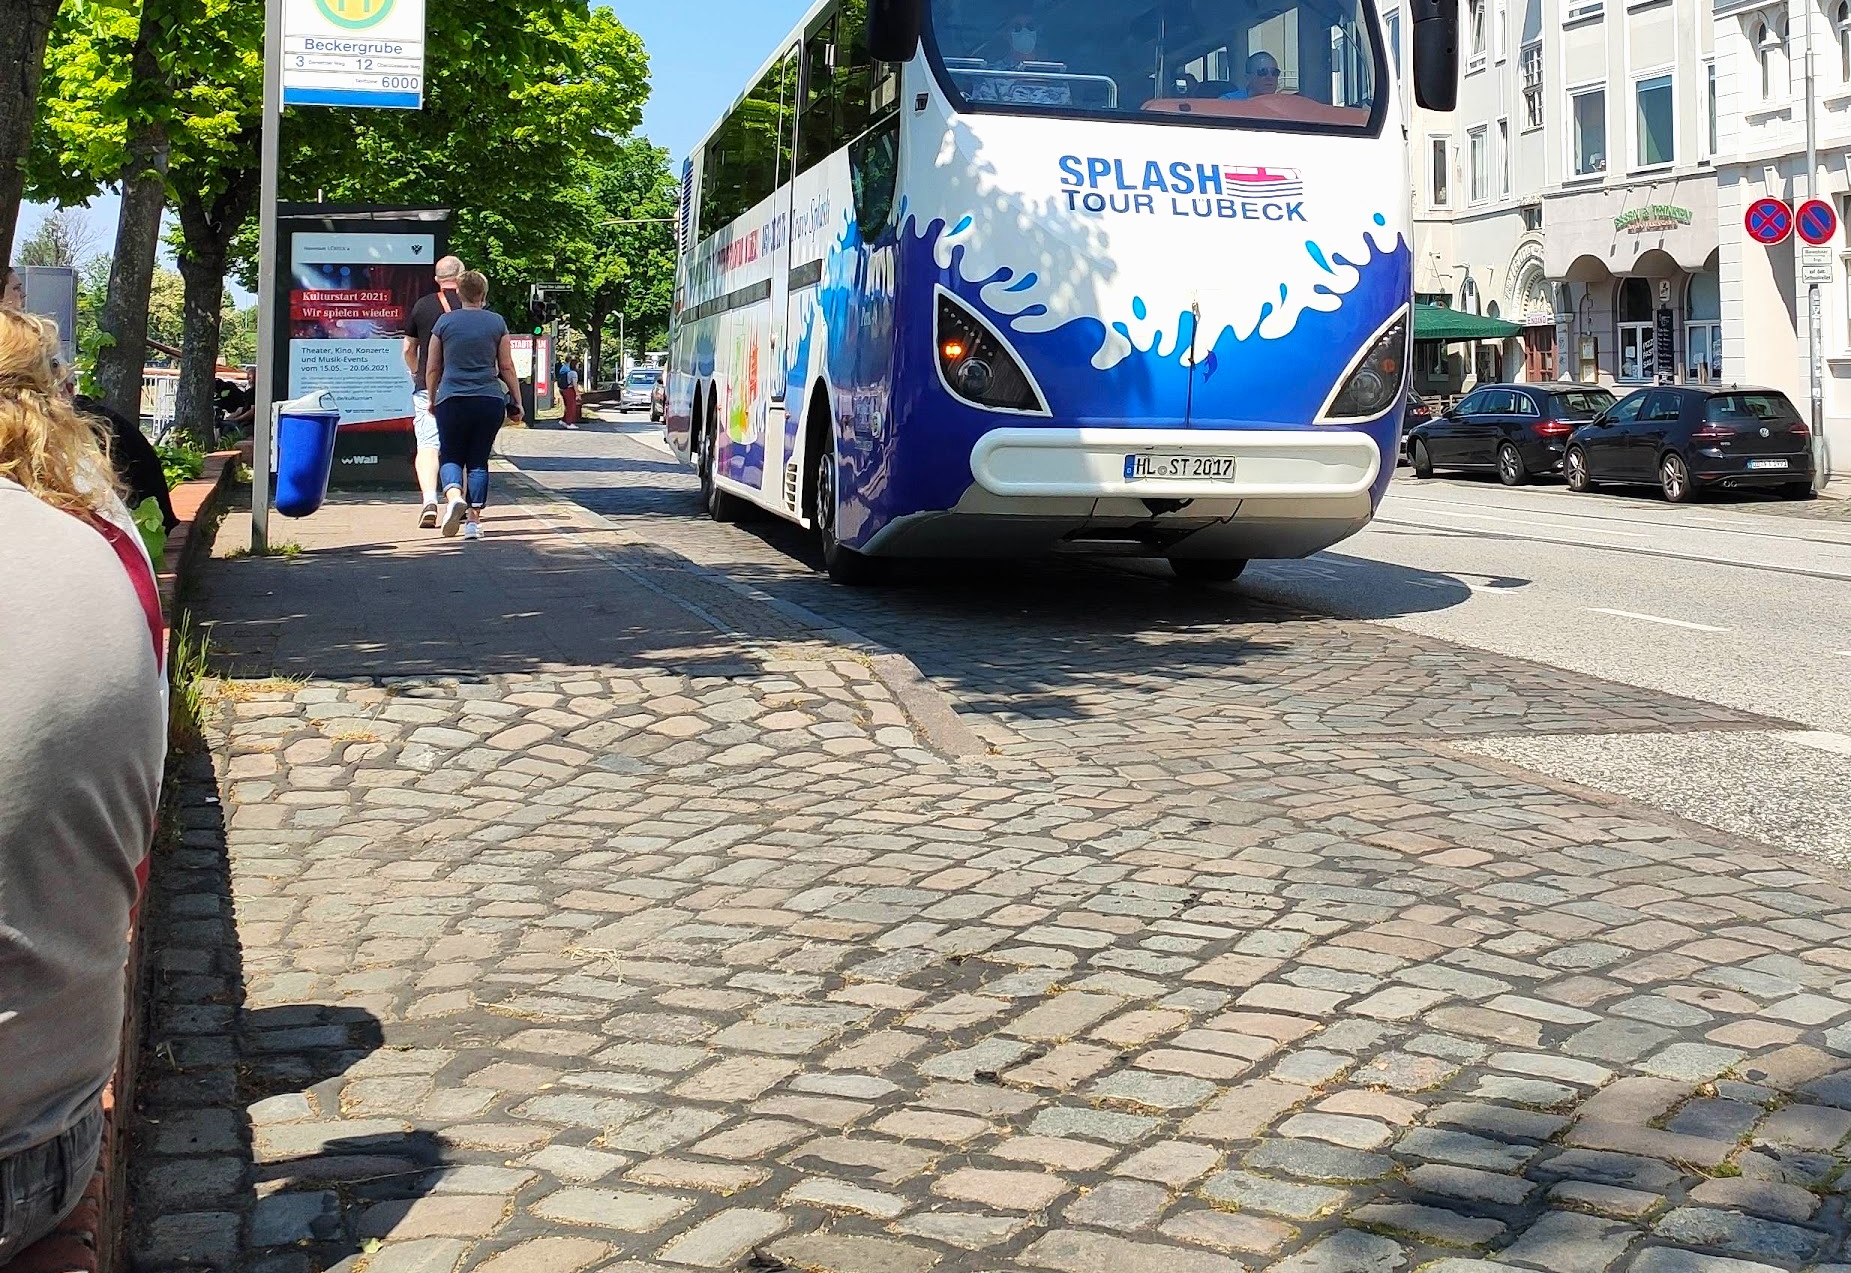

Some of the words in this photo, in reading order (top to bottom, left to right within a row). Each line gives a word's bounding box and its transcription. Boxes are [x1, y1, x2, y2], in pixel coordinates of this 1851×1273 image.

[304, 38, 403, 55] Beckergrube
[295, 55, 305, 68] 3
[355, 58, 373, 71] 12
[381, 76, 419, 90] 6000
[1058, 154, 1223, 195] SPLASH
[1061, 189, 1155, 215] TOUR
[302, 291, 358, 301] Kulturstart
[360, 292, 388, 301] 2021:
[302, 308, 321, 317] Wir
[323, 307, 359, 319] spielen
[362, 308, 399, 317] wieder!
[301, 347, 333, 355] Theater,
[335, 347, 354, 355] Kino,
[349, 364, 389, 372] 20.06.2021
[353, 455, 378, 464] Wall
[1136, 457, 1156, 476] HL
[1169, 458, 1190, 476] ST
[1193, 458, 1233, 476] 2017
